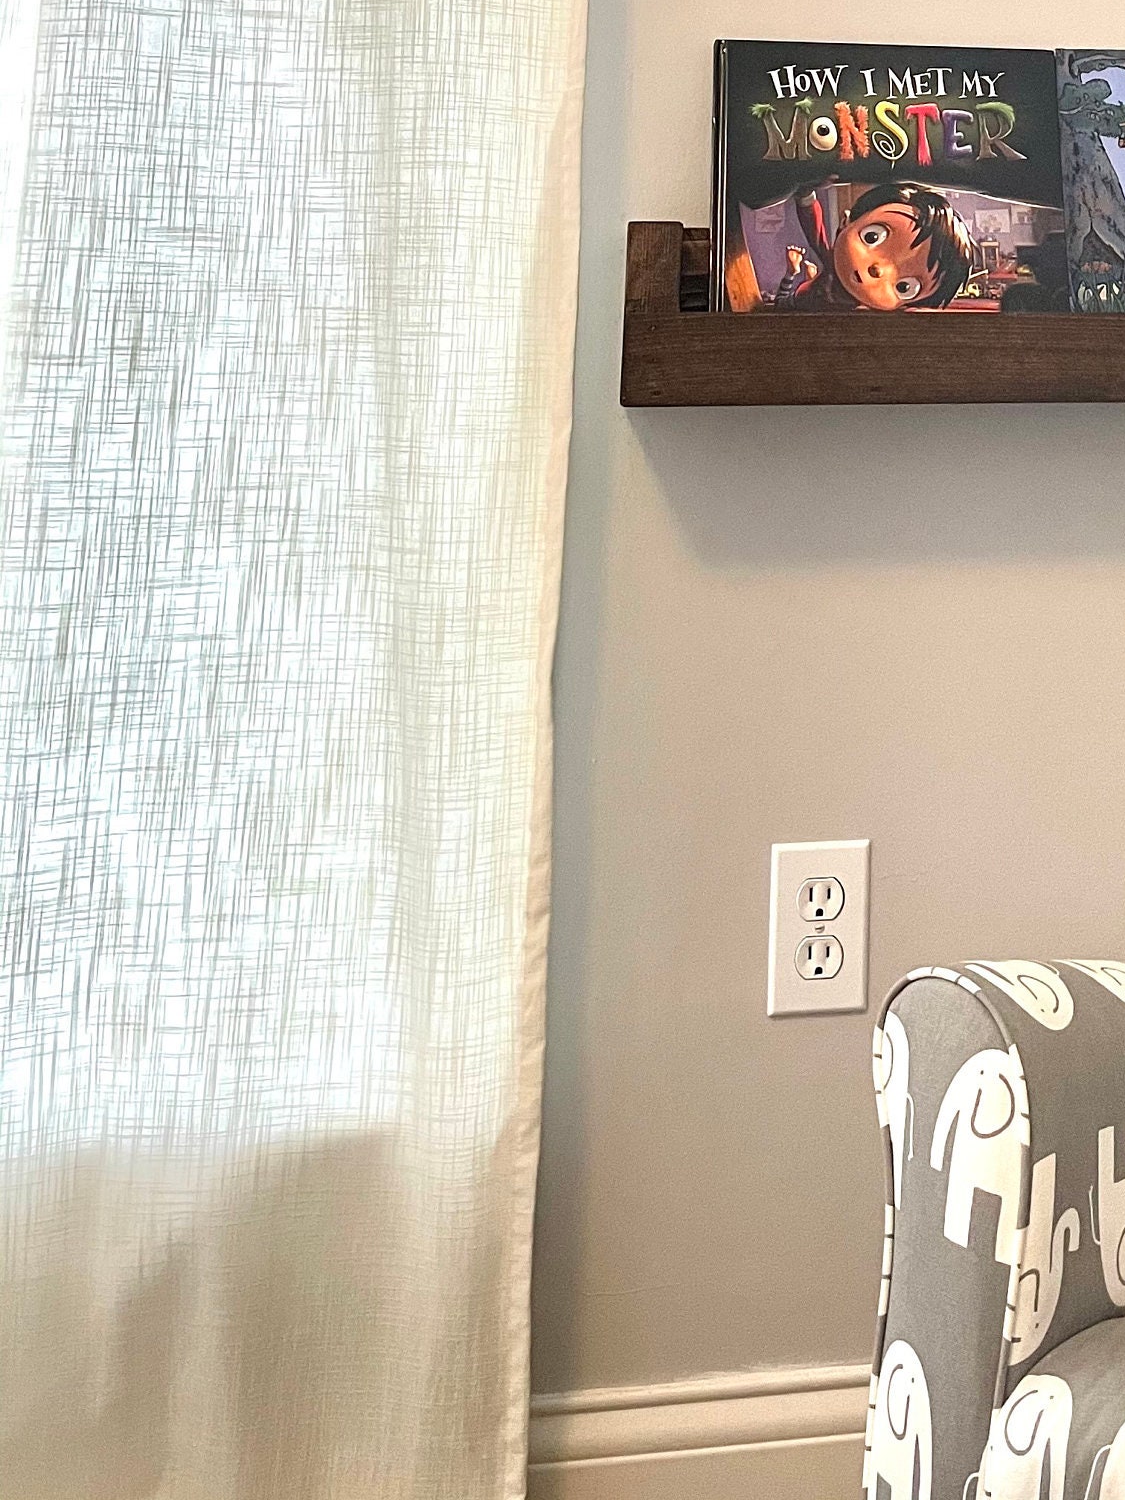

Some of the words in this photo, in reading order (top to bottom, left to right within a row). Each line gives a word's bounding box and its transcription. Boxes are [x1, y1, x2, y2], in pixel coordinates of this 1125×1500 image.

[860, 68, 878, 97] I
[887, 67, 953, 99] MET
[958, 71, 1005, 99] MY
[751, 97, 1028, 169] MONSTER
